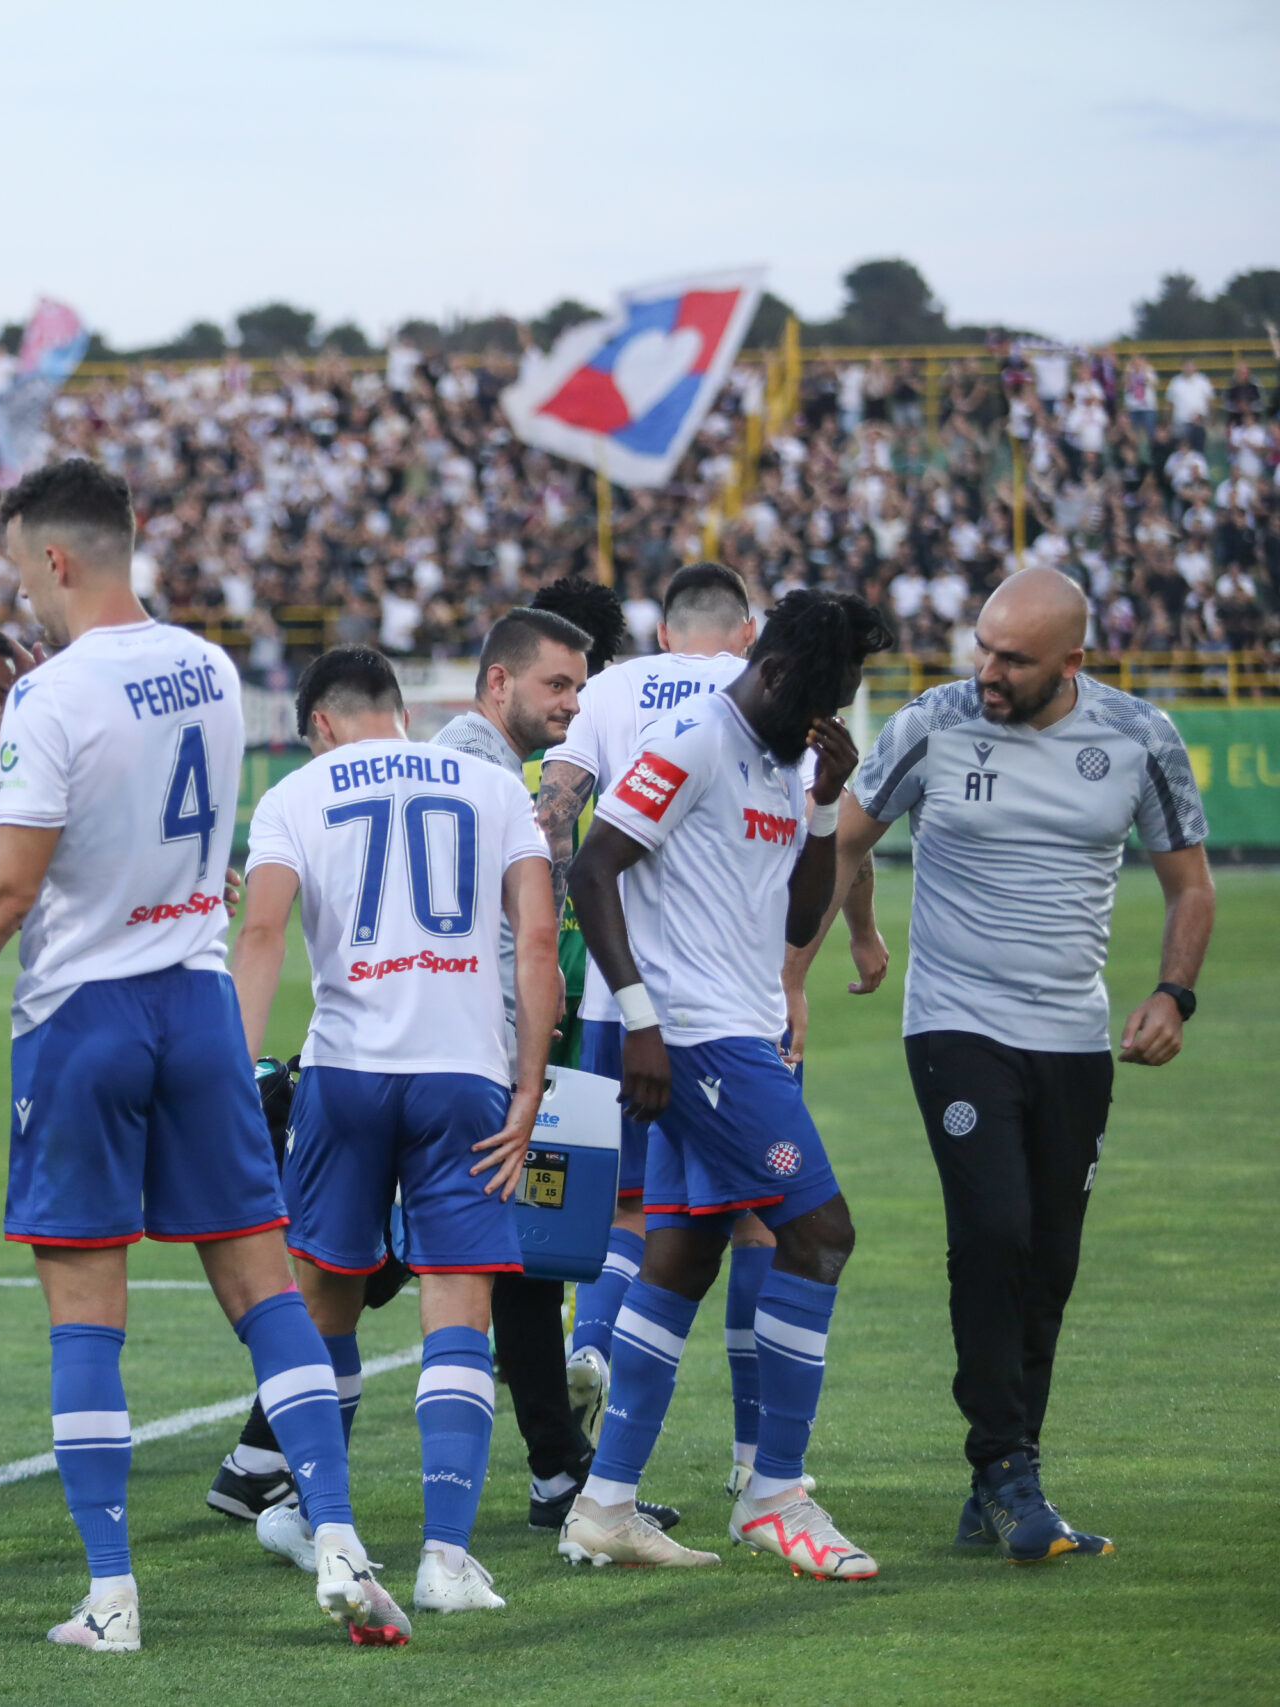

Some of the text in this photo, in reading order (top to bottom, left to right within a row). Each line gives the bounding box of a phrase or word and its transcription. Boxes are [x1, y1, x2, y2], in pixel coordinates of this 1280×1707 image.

[124, 654, 224, 720] PERIŠIĆ
[330, 754, 460, 792] BREKALO
[634, 762, 677, 792] Super
[965, 772, 998, 802] AT
[160, 720, 218, 882] 4
[625, 775, 667, 805] Sport
[322, 793, 479, 946] 70
[348, 950, 479, 982] SuperSport
[535, 1172, 551, 1183] 16
[545, 1188, 557, 1197] 15
